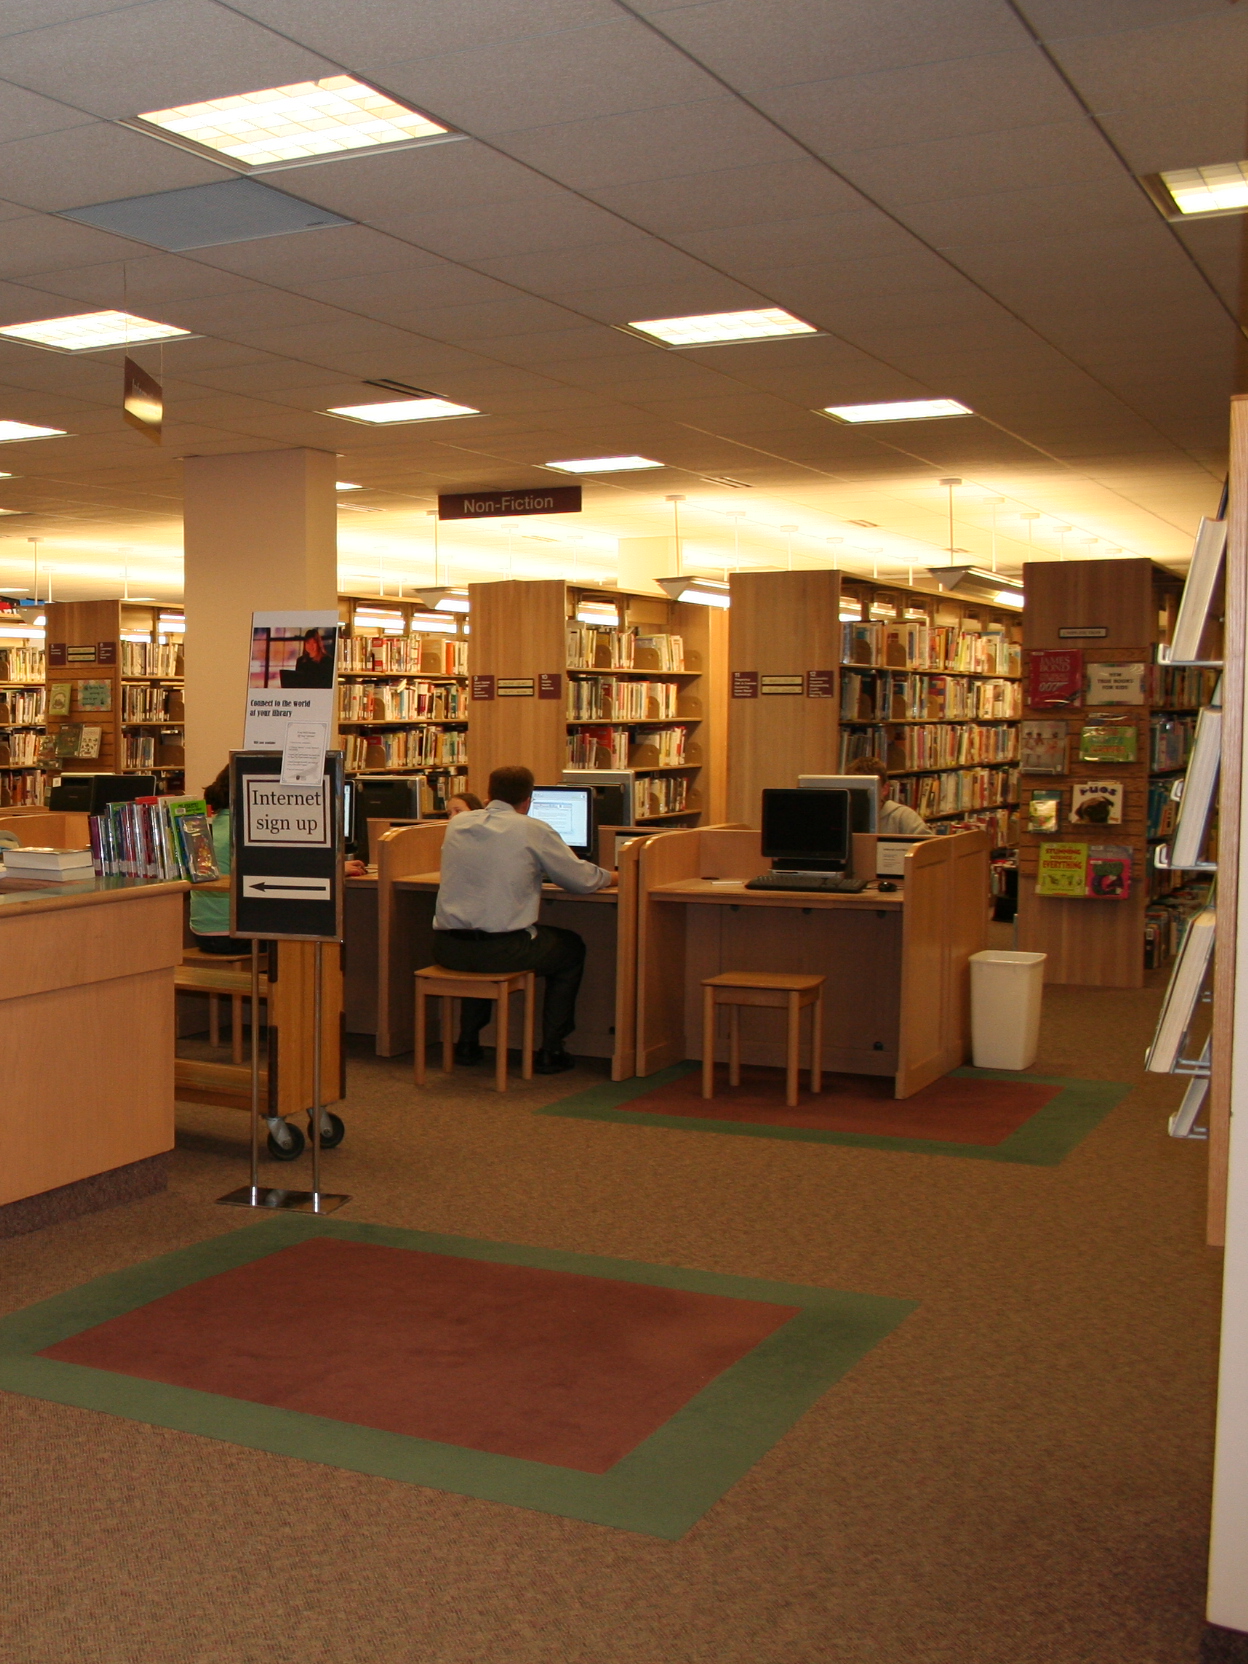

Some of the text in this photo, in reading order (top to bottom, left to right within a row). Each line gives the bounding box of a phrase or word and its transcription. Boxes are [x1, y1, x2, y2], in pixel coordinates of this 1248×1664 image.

[463, 496, 554, 513] Non-Fiction
[1039, 663, 1071, 672] BOND
[1038, 682, 1064, 692] 007
[250, 699, 273, 707] Connect
[293, 700, 311, 708] world
[257, 709, 271, 718] your
[272, 709, 293, 718] library
[252, 789, 321, 806] Internet
[256, 814, 318, 835] sign up
